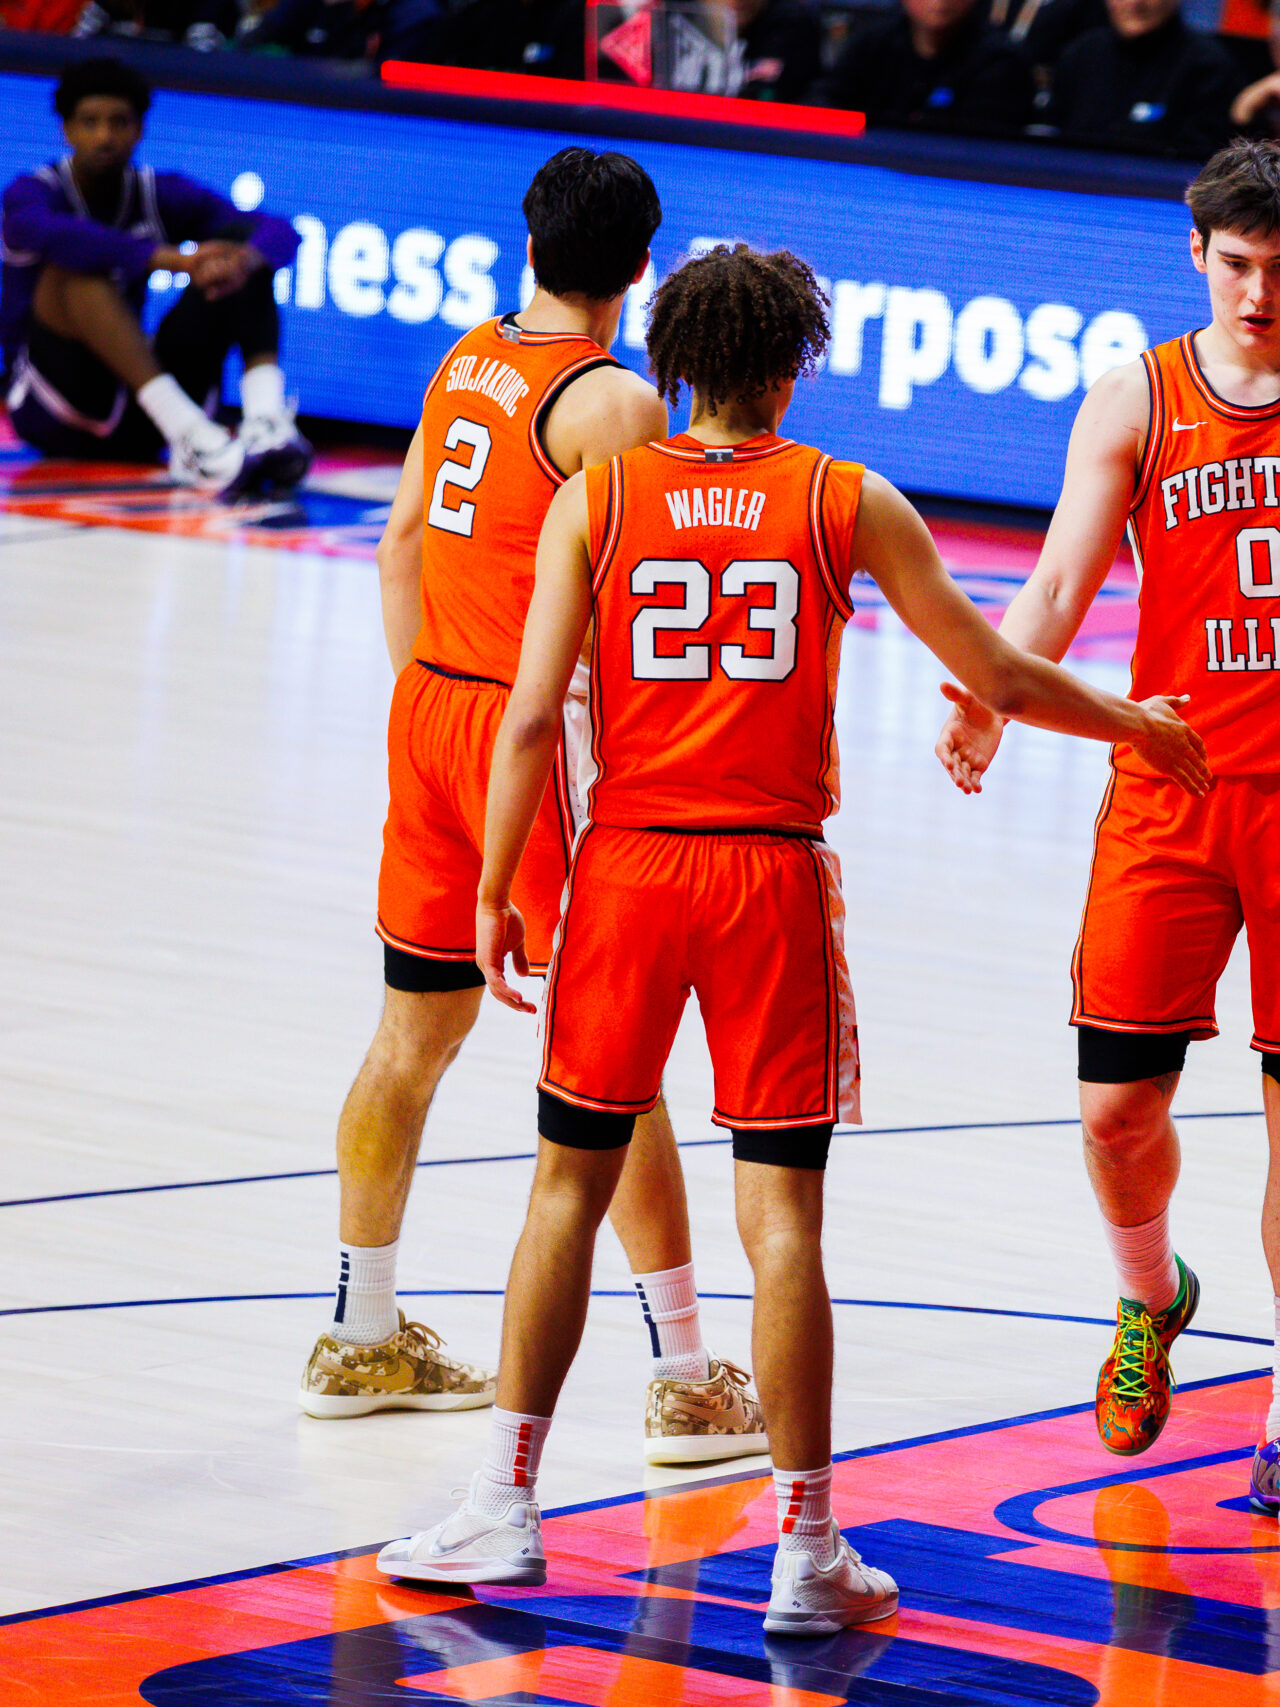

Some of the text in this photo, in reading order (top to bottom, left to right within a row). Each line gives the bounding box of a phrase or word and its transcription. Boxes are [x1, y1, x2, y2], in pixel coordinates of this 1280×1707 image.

[446, 355, 530, 418] STOJAKOVIC
[427, 416, 492, 538] 2
[665, 487, 766, 531] WAGLER
[630, 558, 800, 682] 23
